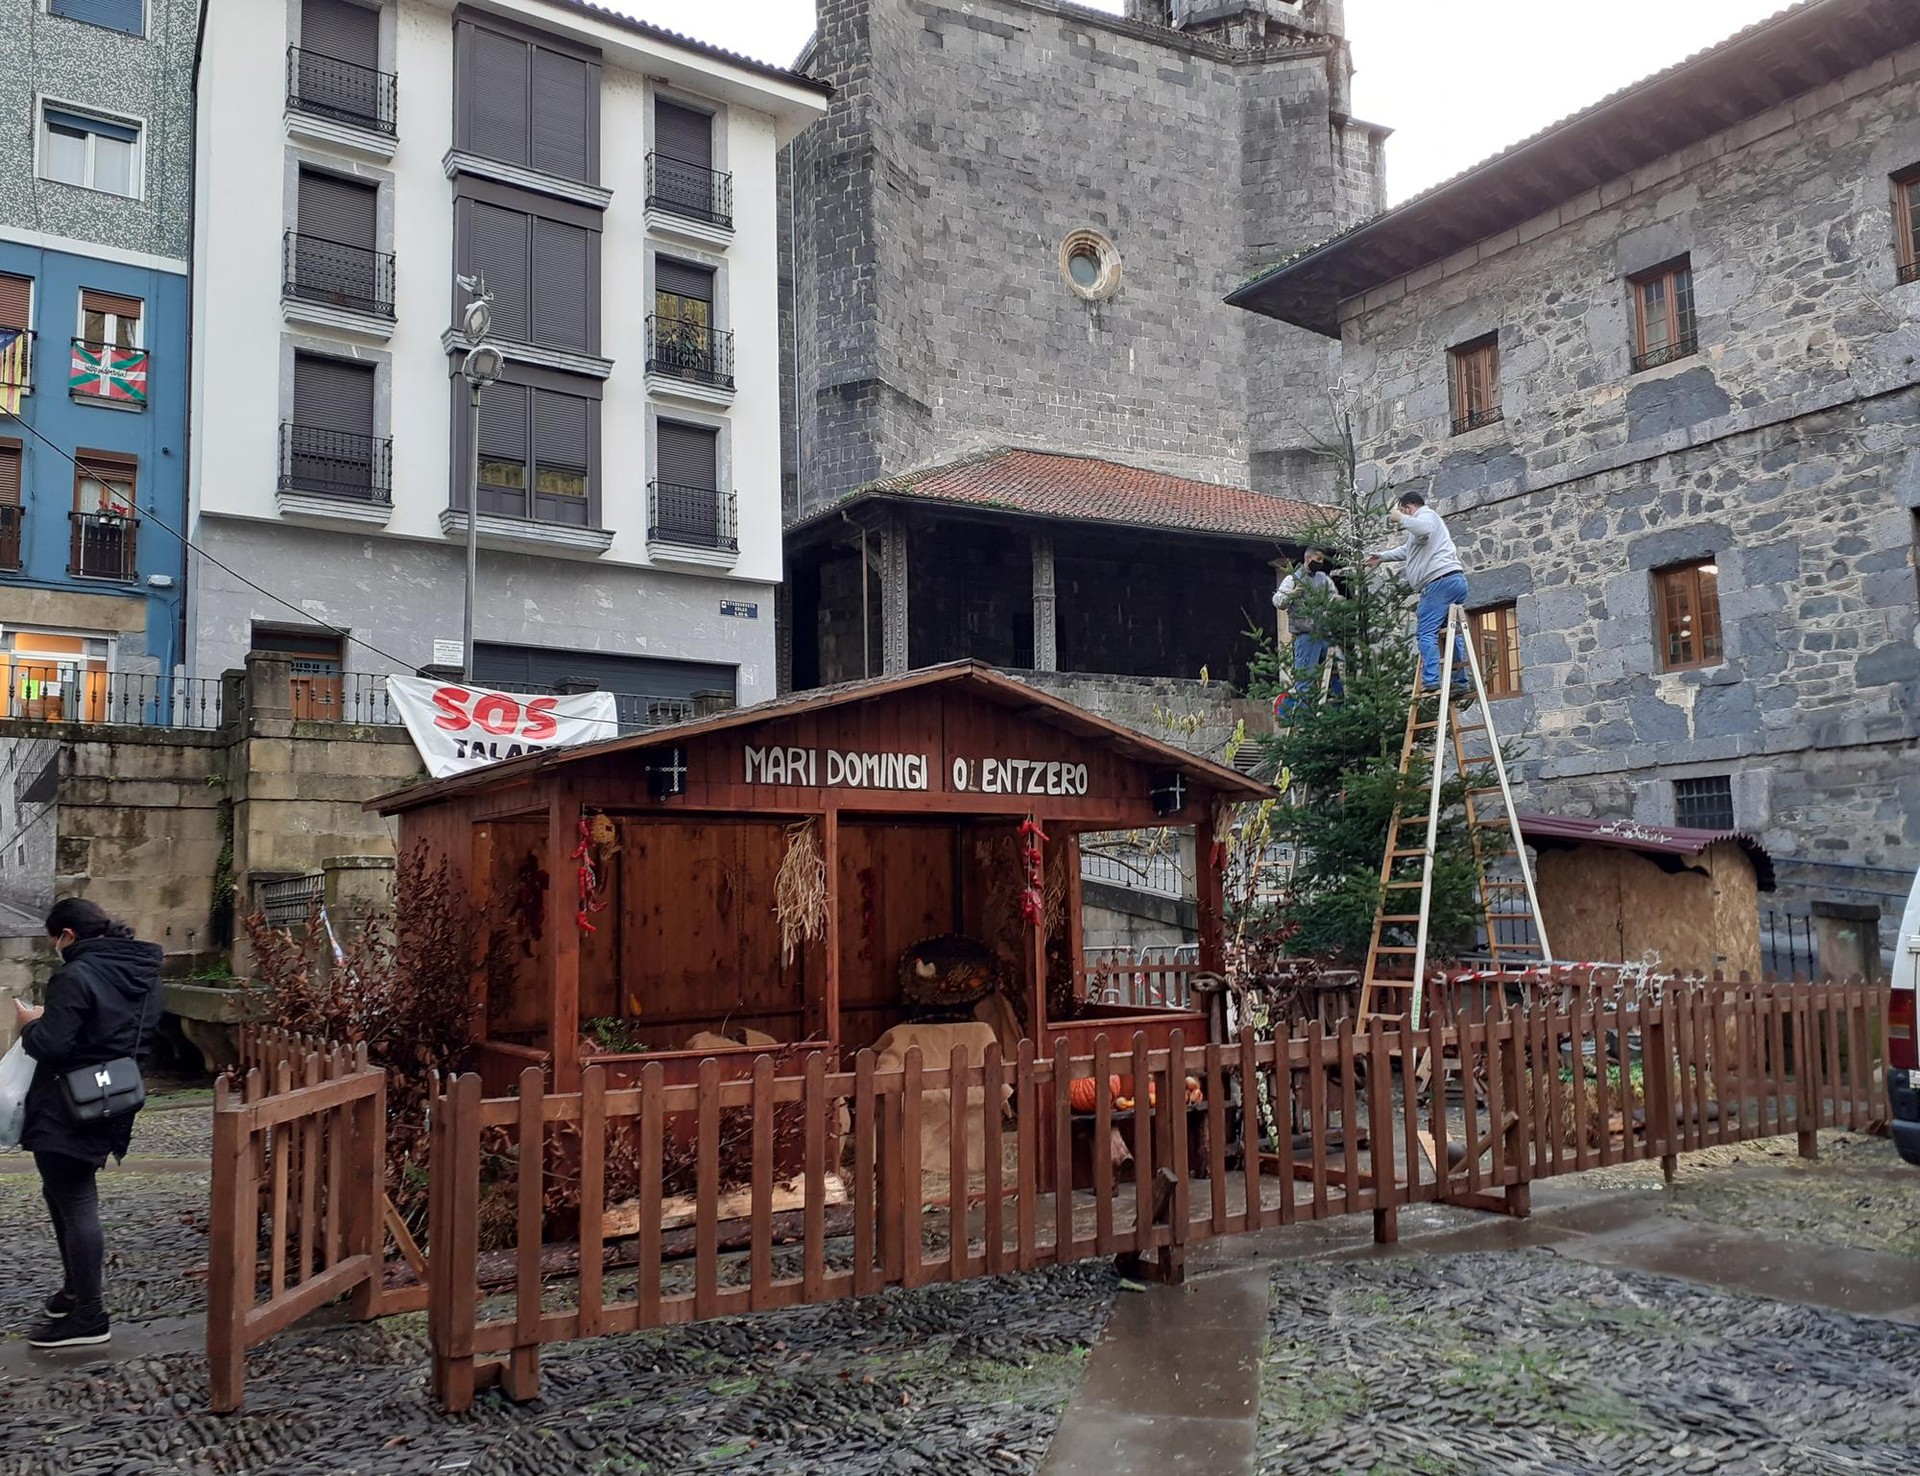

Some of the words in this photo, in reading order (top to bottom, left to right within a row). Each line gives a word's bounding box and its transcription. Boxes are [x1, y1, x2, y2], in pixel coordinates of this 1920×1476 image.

[433, 687, 559, 738] SOS
[745, 745, 816, 786] MARI
[827, 749, 927, 789] DOMINGI
